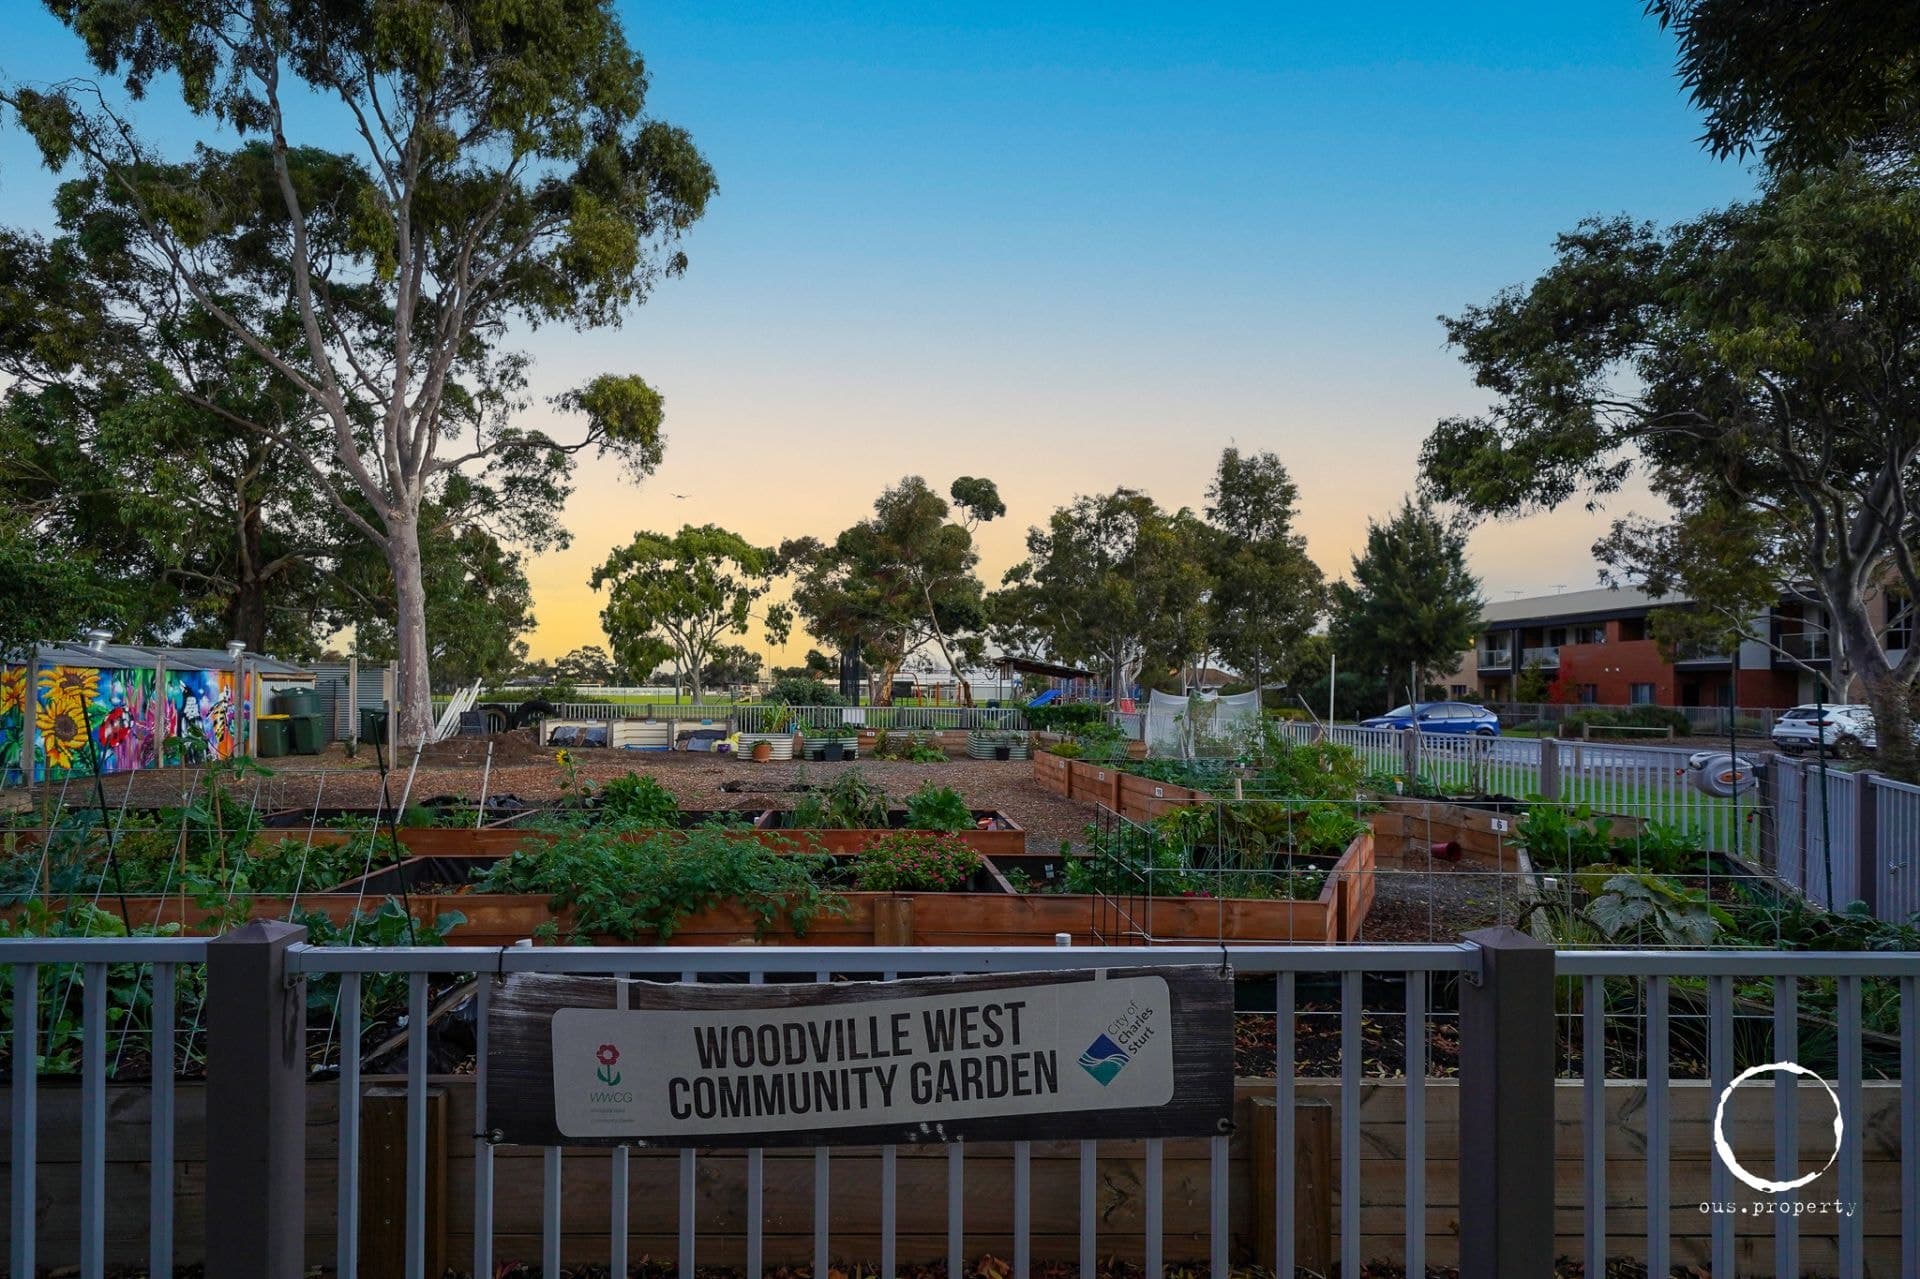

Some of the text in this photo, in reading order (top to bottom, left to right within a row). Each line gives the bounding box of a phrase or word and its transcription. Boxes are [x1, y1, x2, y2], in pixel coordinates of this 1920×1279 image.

[694, 1001, 1026, 1069] WOODVILLE WEST
[1107, 1000, 1139, 1035] City of
[1117, 1007, 1153, 1045] Charles
[1128, 1026, 1155, 1055] Sturt
[590, 1092, 632, 1103] WWCG
[668, 1050, 1058, 1120] COMMUNITY GARDEN
